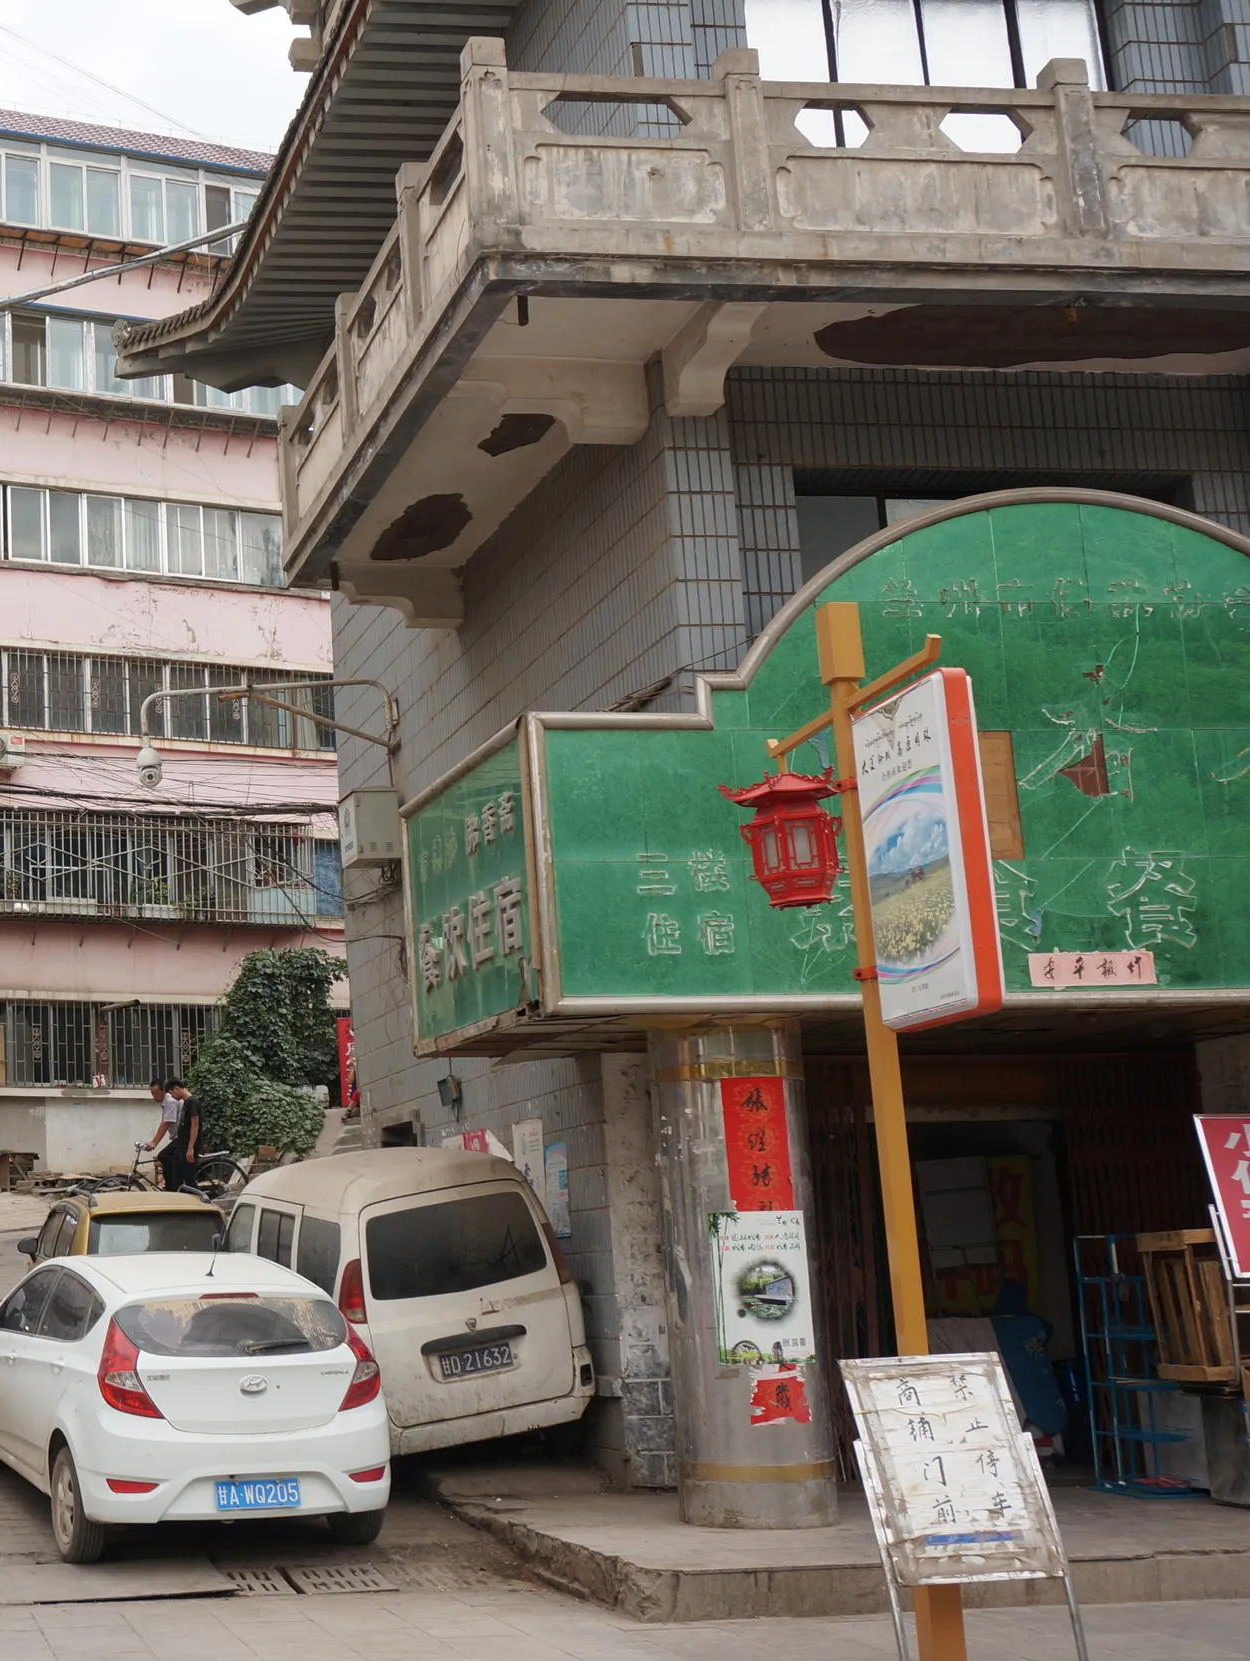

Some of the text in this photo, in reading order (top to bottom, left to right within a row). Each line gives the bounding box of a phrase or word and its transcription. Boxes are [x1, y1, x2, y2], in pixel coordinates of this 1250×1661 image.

[419, 876, 522, 995] 餐饮住宿
[217, 1482, 299, 1506] 甘A·WQ205
[895, 1378, 956, 1524] 商铺门前
[949, 1373, 1012, 1518] 禁止停车
